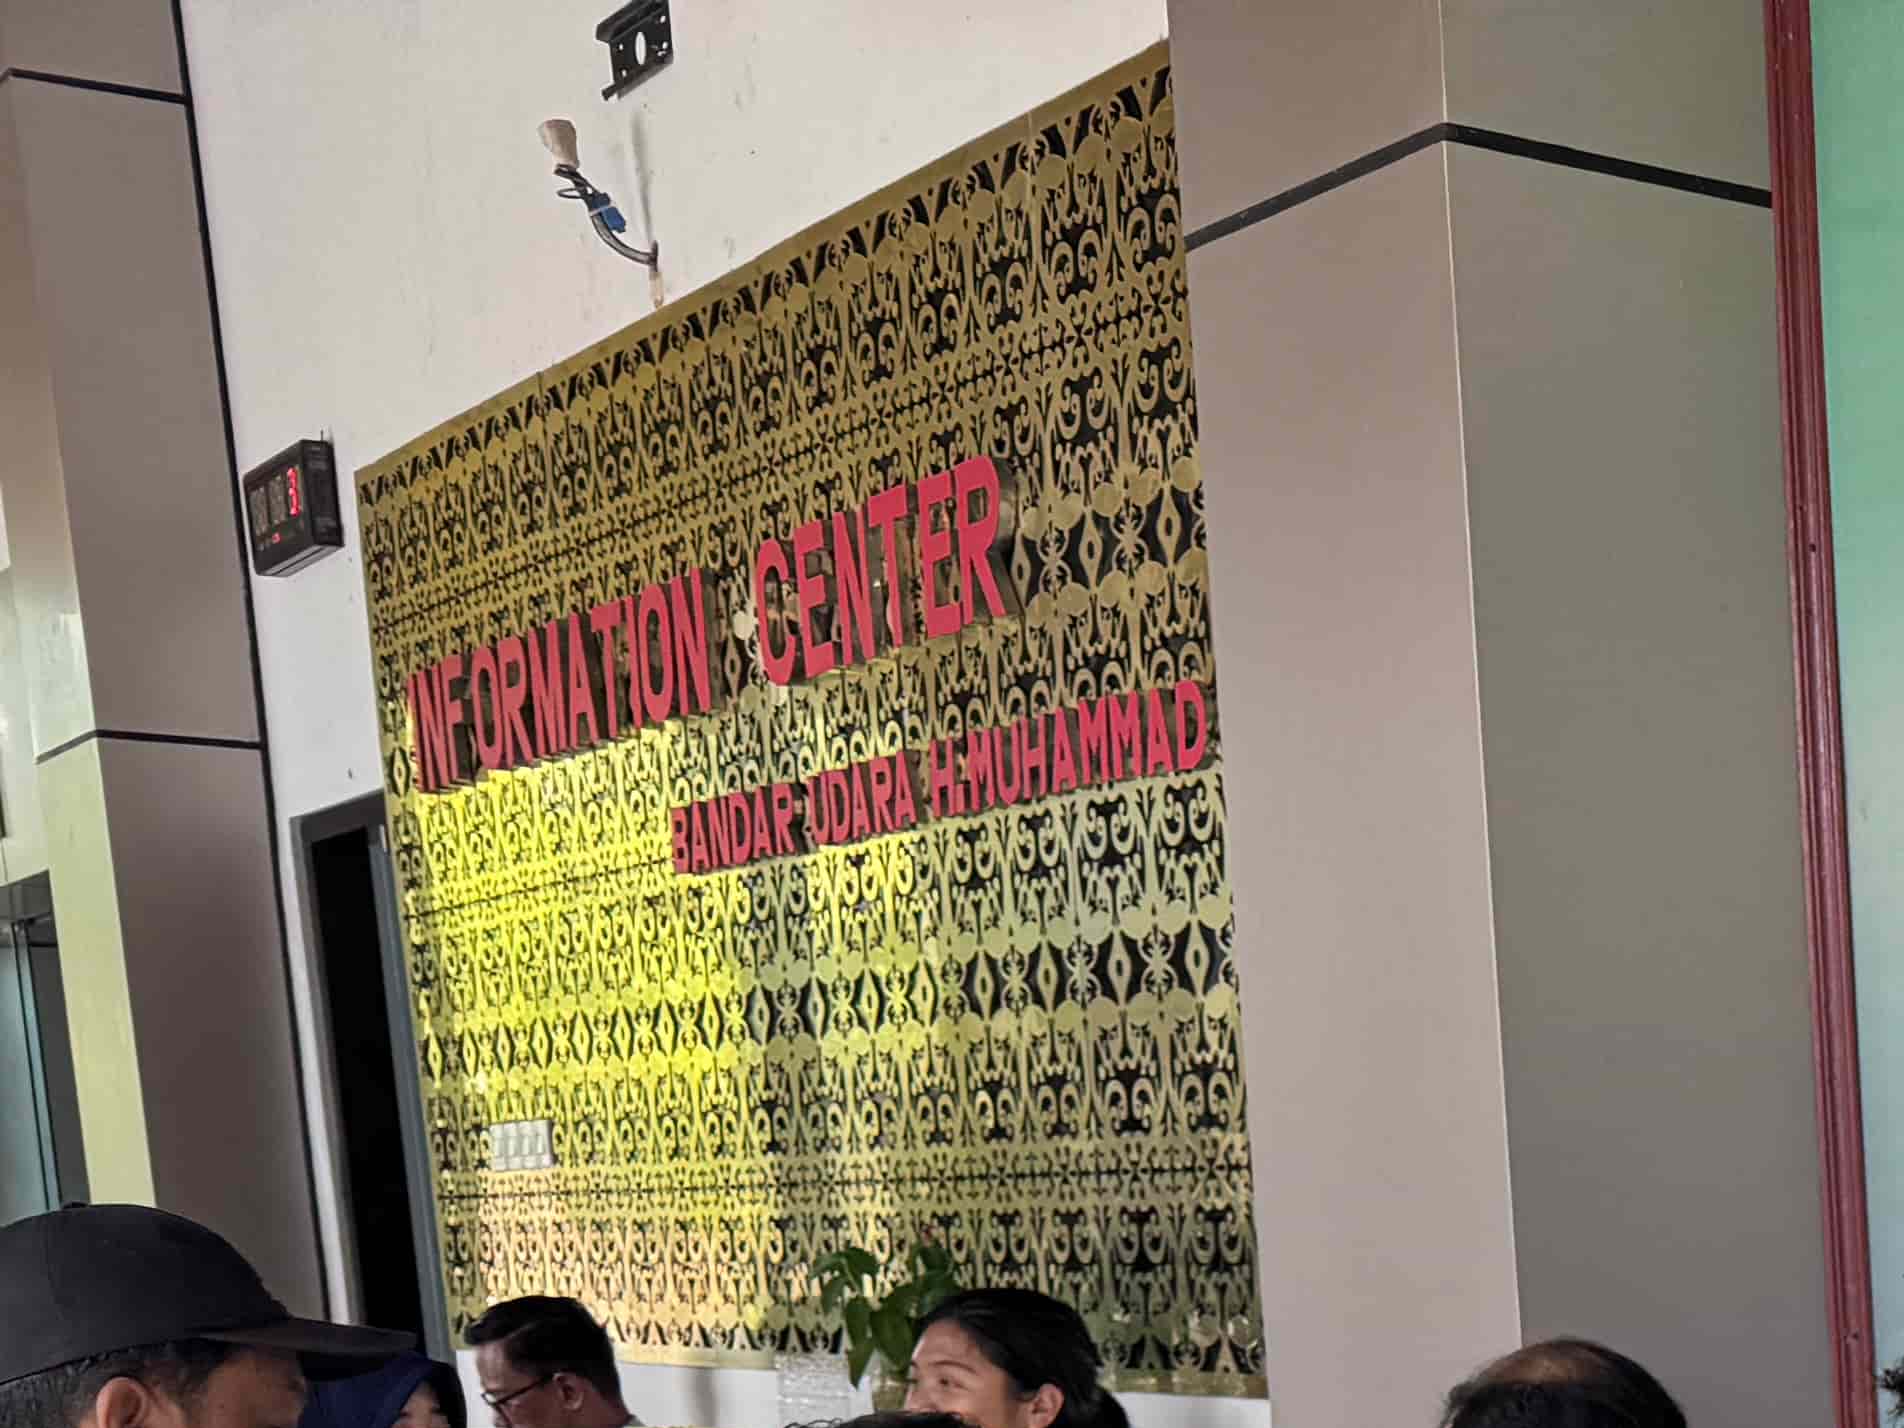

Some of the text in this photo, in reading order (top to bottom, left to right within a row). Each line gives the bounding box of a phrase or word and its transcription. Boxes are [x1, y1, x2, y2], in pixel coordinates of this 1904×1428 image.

[407, 454, 1007, 794] INFORMATION CENTER
[671, 680, 1209, 873] BANDAR UDARA H.MUHAMMAD
